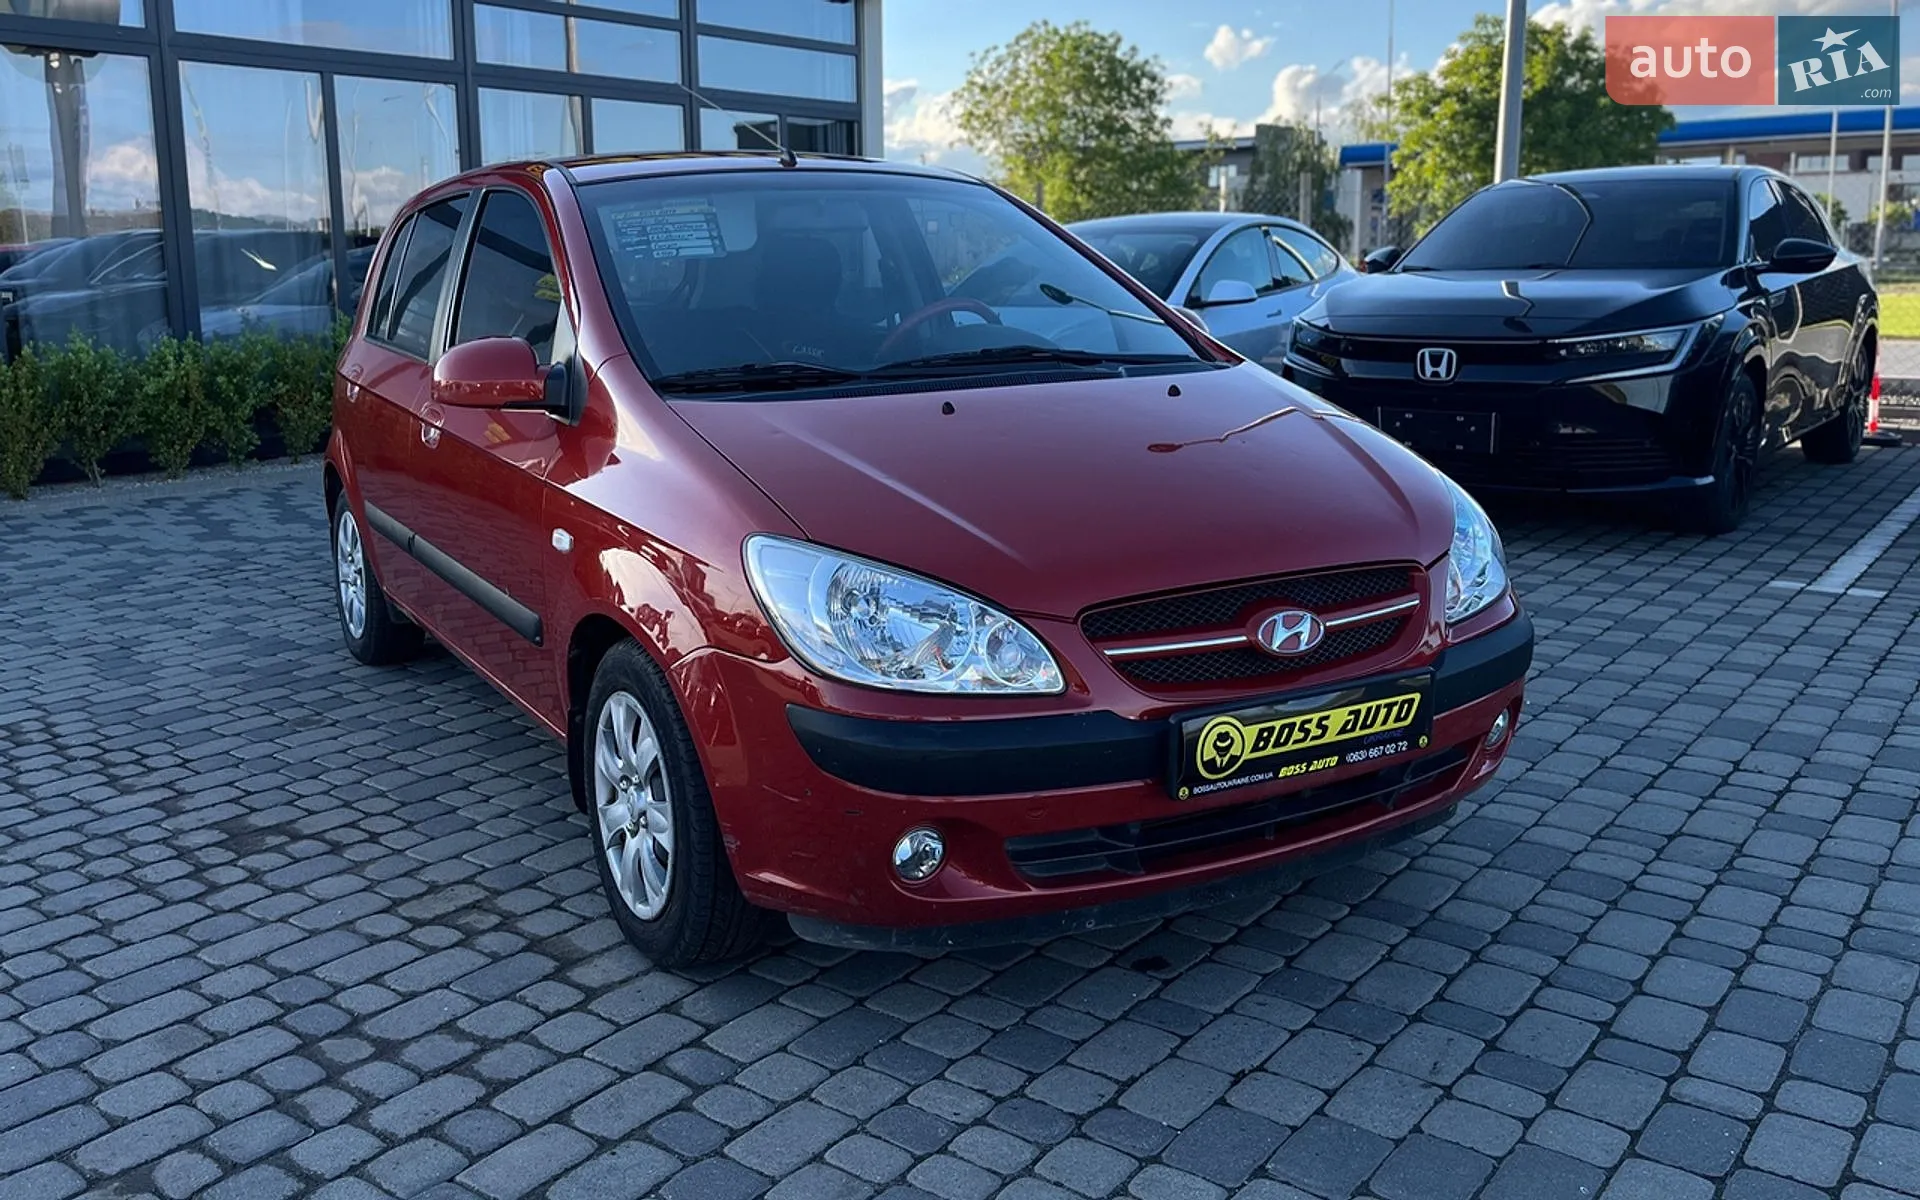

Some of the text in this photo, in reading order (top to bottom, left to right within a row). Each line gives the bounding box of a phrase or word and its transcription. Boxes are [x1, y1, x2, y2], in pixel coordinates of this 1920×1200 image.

[1250, 697, 1416, 753] BOSS AUTO
[1385, 744, 1397, 755] 02
[1397, 741, 1409, 752] 72
[1278, 756, 1339, 777] BOSS AUTO
